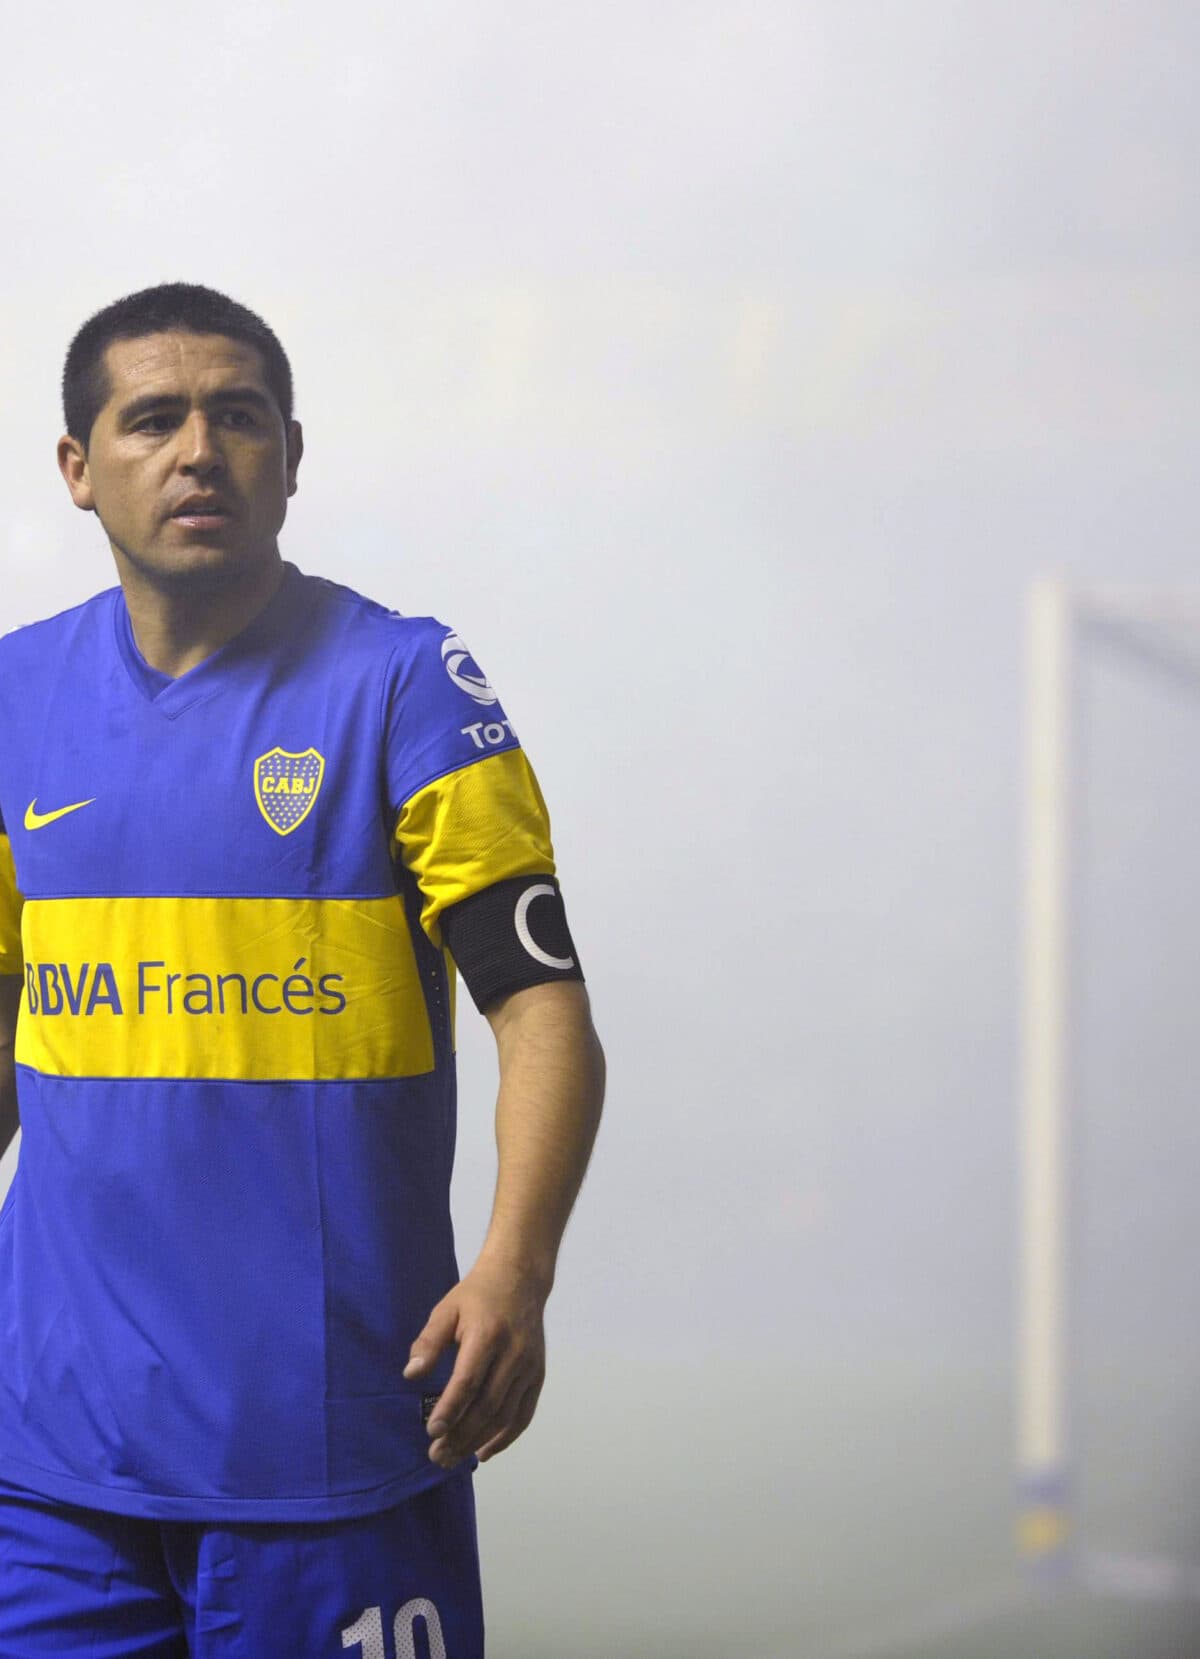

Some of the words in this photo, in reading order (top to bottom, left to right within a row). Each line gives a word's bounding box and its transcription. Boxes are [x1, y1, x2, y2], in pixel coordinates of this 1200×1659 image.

[262, 776, 315, 794] CABJ
[514, 884, 575, 969] C
[25, 963, 123, 1016] BBVA
[137, 957, 347, 1016] Francés
